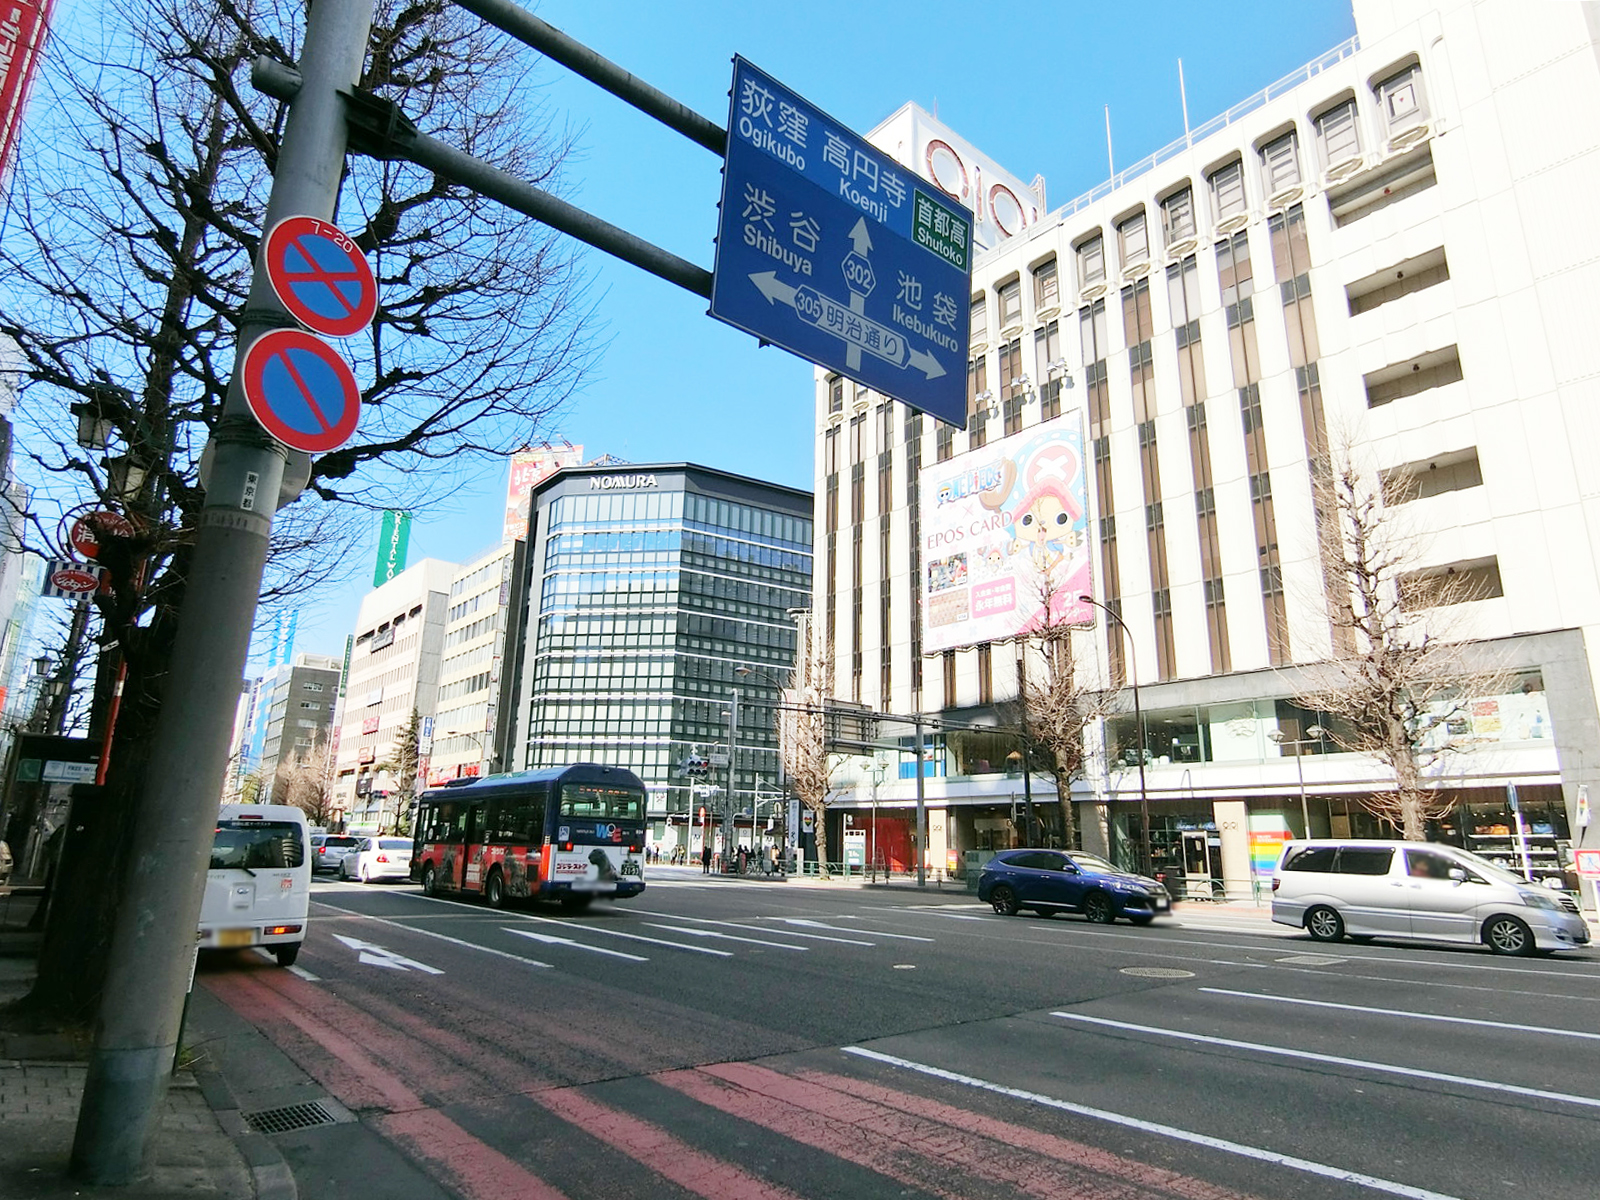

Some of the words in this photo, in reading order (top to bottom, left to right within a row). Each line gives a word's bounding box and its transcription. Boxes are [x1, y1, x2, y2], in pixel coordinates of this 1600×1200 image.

[741, 78, 808, 149] 荻窪
[739, 117, 806, 171] Ogikubo
[823, 130, 906, 208] 高円寺
[742, 183, 820, 253] 渋谷
[839, 178, 888, 223] Koenji
[917, 198, 966, 249] 首都高
[311, 220, 353, 253] 7-20
[743, 223, 812, 276] Shibuya
[917, 229, 963, 266] Shutoko
[846, 260, 871, 287] 302
[797, 291, 821, 318] 305
[896, 270, 958, 331] 池袋
[826, 308, 898, 356] 明治通り
[893, 304, 959, 353] Ikebukuro
[514, 463, 542, 486] 北京
[590, 475, 658, 490] NOMURA
[390, 510, 403, 561] ORIENTAL
[928, 526, 964, 549] EPOS
[970, 511, 1013, 537] CARD
[1063, 589, 1084, 608] 2F
